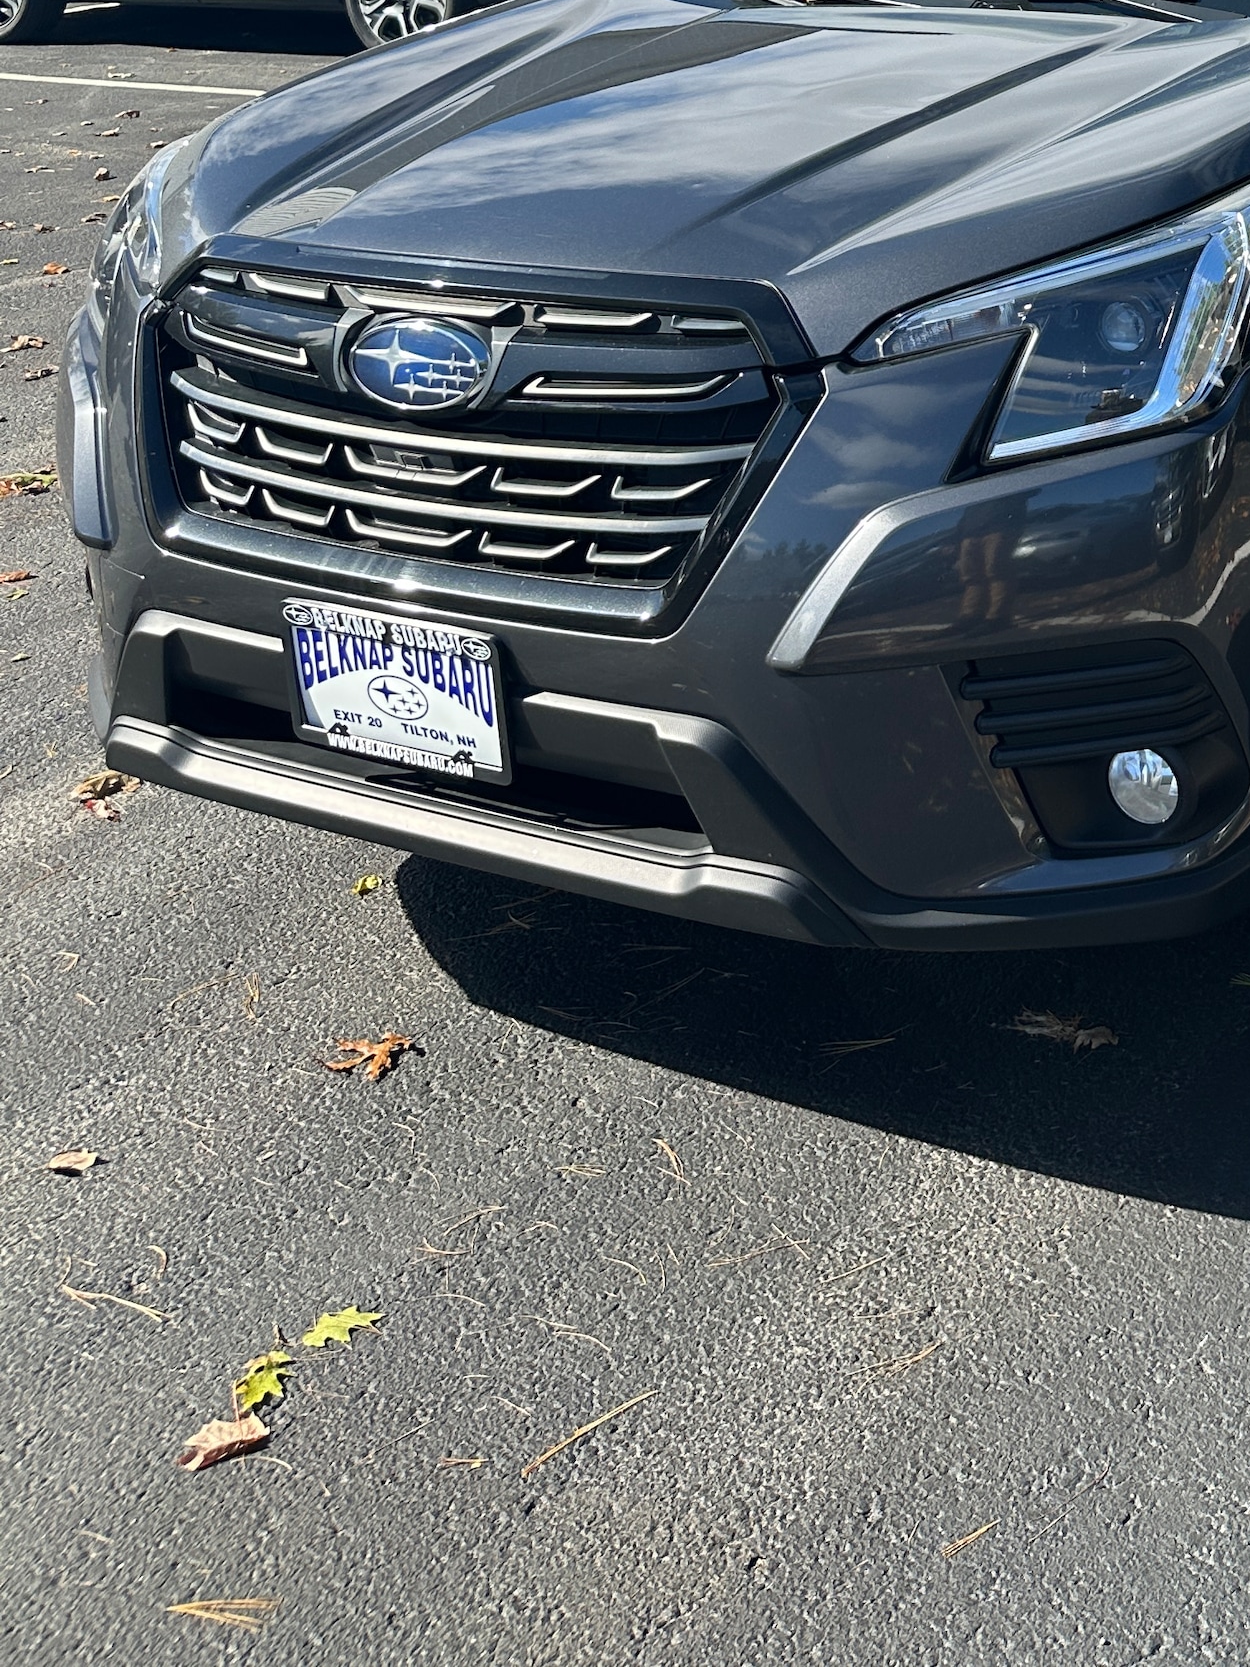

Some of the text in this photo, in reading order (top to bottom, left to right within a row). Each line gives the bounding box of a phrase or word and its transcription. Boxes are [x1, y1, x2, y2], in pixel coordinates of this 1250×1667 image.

[313, 607, 462, 656] BELKNAP SUBARU
[297, 628, 494, 728] BELKNAP SUBARU
[333, 708, 383, 728] EXIT 20
[401, 722, 477, 748] TILTON, NH
[326, 732, 475, 778] WWW.BELKNAPSUBARU.COM
